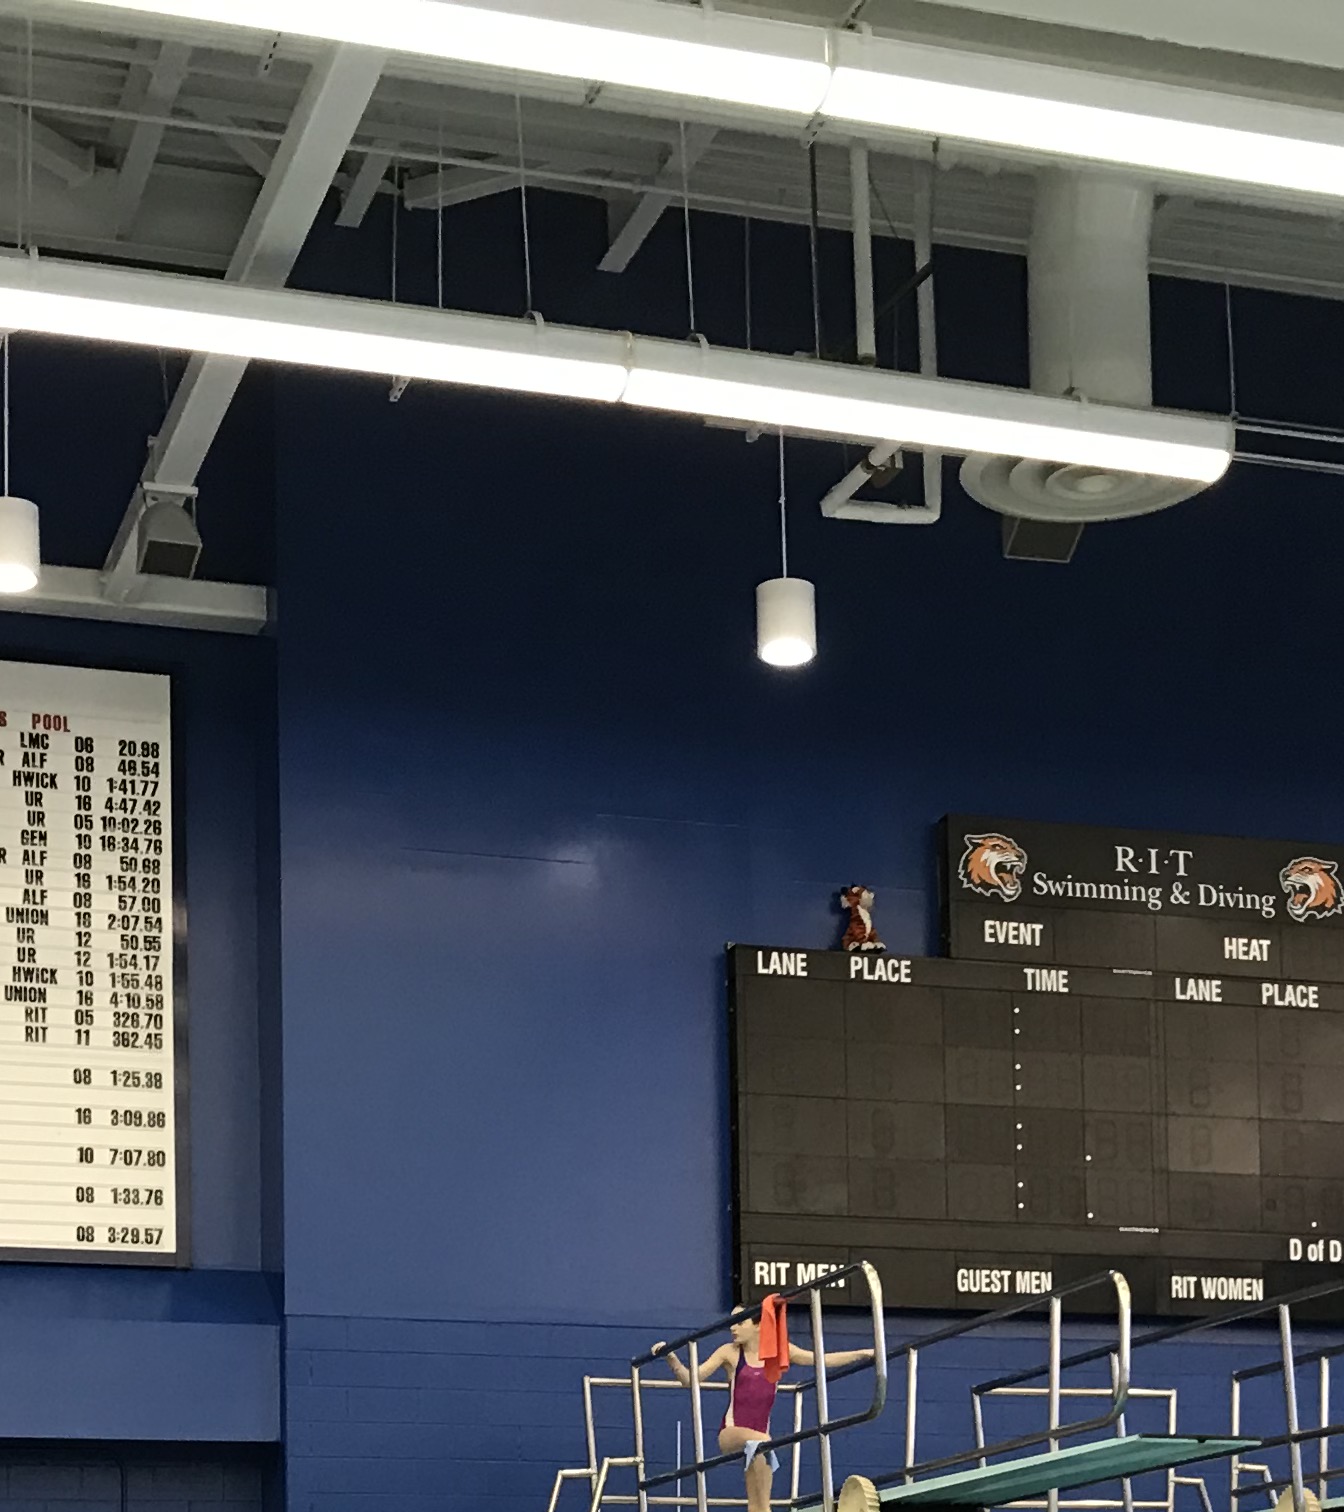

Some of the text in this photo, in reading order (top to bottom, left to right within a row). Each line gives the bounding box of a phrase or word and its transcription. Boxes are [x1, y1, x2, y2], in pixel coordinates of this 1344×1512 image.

[32, 713, 70, 733] POOL
[20, 732, 49, 750] LMC
[22, 752, 47, 769] ALF
[13, 770, 58, 789] HWICK
[107, 778, 159, 796] 1:41.77
[25, 791, 43, 807] UR
[28, 811, 45, 827] UR
[21, 830, 47, 847] GEN
[22, 849, 47, 866] ALF
[25, 870, 43, 885] UR
[22, 889, 47, 905] ALF
[1032, 871, 1276, 919] Swimming & Diving
[6, 906, 48, 926] UNION
[17, 927, 35, 944] UR
[984, 920, 1043, 947] EVENT
[17, 947, 36, 963] UR
[1224, 937, 1270, 962] HEAT
[12, 966, 58, 985] HWICK
[758, 952, 1068, 993] LANE PLACE TIME
[5, 985, 46, 1003] UNION
[1175, 978, 1221, 1003] LANE
[1261, 983, 1318, 1009] PLACE
[25, 1007, 47, 1023] RIT
[25, 1026, 48, 1043] RIT
[109, 1149, 165, 1167] 7:07.80
[1289, 1239, 1342, 1262] D of D
[755, 1262, 790, 1285] RIT
[957, 1269, 1052, 1294] GUEST MEN
[1171, 1276, 1263, 1301] RIT WOMEN
